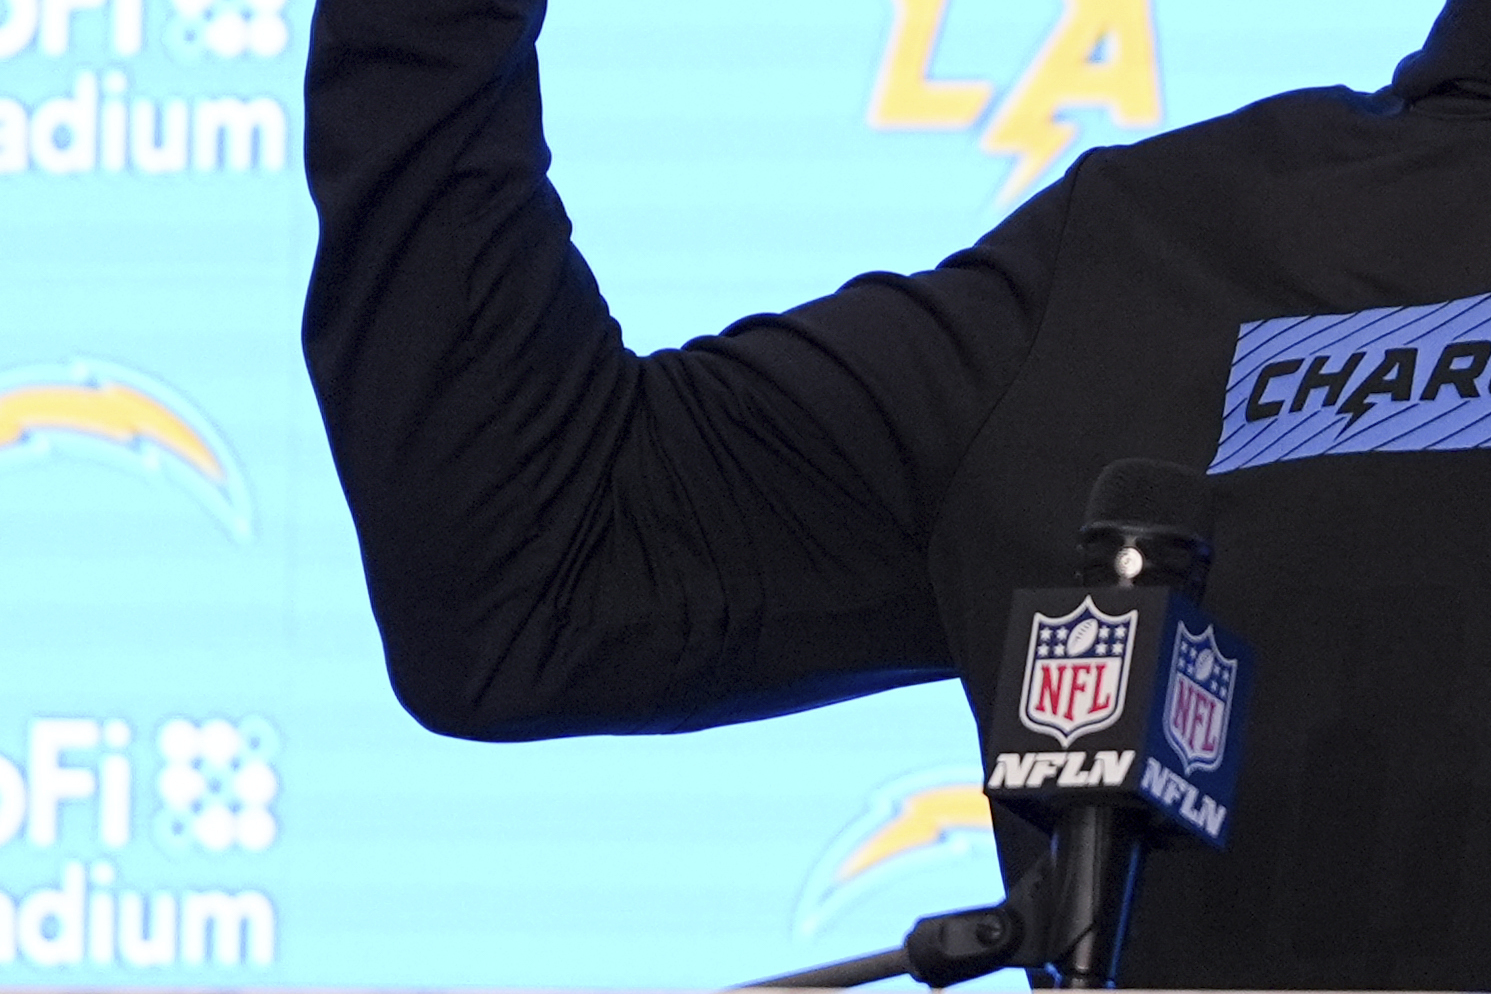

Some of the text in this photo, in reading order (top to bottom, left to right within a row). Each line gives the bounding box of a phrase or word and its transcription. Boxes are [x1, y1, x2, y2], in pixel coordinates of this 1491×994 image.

[1035, 661, 1112, 722] NFL
[1173, 679, 1218, 752] NFL
[987, 749, 1137, 790] NFLN
[1140, 756, 1228, 840] NFLN
